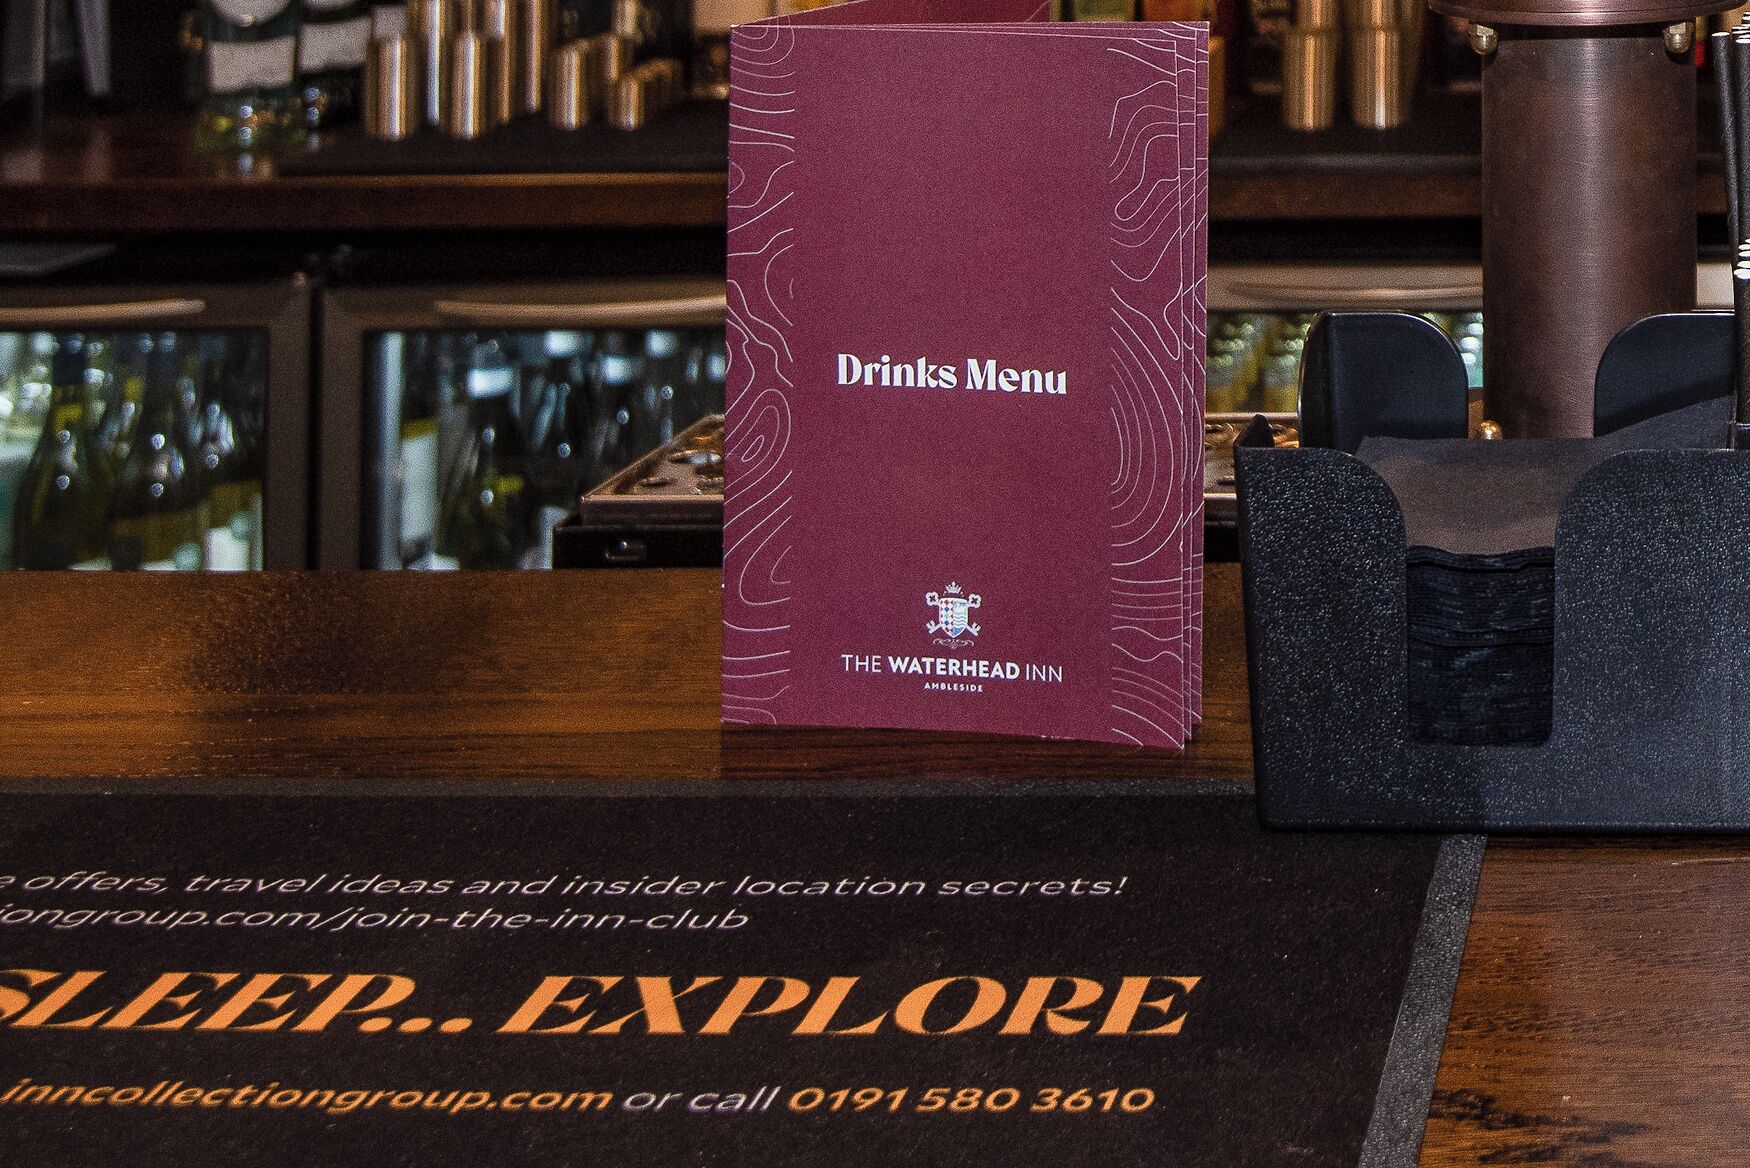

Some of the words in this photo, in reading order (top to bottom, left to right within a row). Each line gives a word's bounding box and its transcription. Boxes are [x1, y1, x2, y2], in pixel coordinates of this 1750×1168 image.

[836, 352, 958, 390] Drinks
[965, 357, 1068, 395] Menu
[841, 654, 882, 673] THE
[887, 656, 1021, 681] WATERHEAD
[1025, 664, 1064, 683] INN
[924, 682, 984, 693] AMBLESIDE
[24, 871, 169, 894] offers,
[184, 873, 328, 896] travel
[327, 874, 450, 895] ideas
[459, 875, 558, 896] and
[560, 876, 726, 896] insider
[732, 875, 926, 896] location
[937, 876, 1129, 896] secrets!
[494, 974, 1202, 1036] EXPLORE
[0, 1077, 613, 1115] inncollectiongroup.com
[621, 1089, 682, 1113] or
[687, 1085, 780, 1113] call
[787, 1086, 905, 1114] 0191
[915, 1086, 1021, 1114] 580
[1030, 1086, 1157, 1114] 3610
